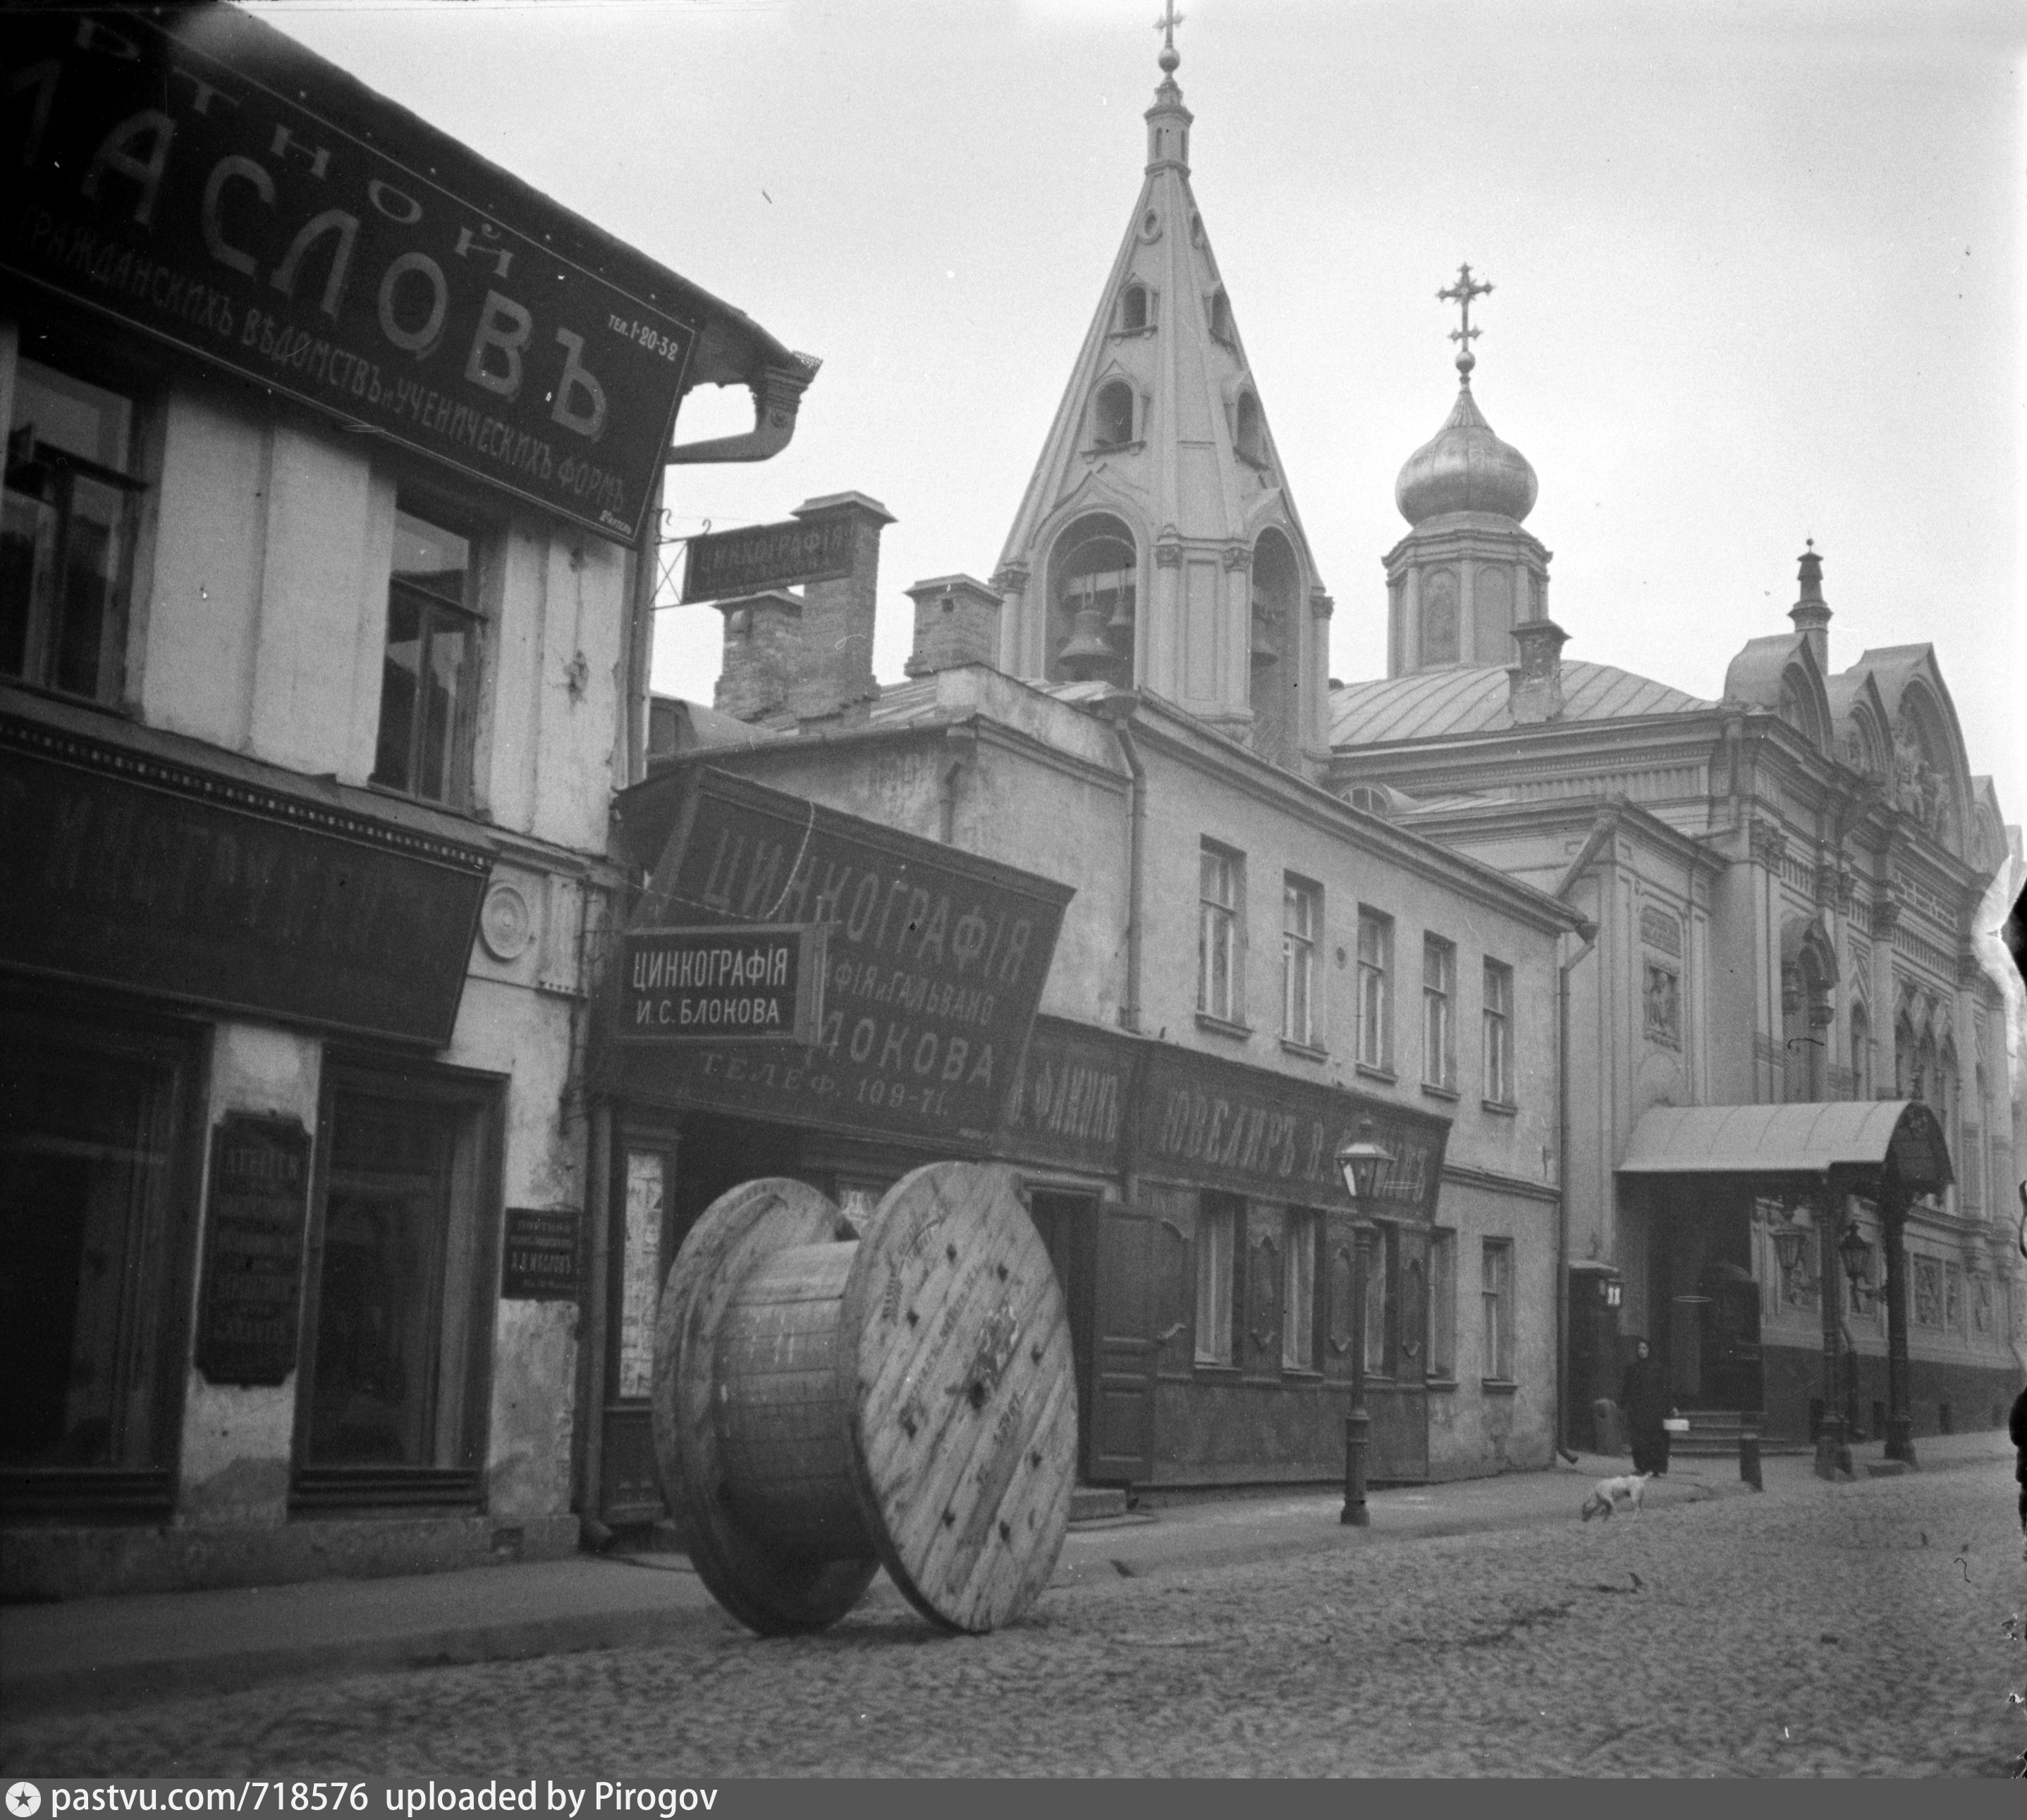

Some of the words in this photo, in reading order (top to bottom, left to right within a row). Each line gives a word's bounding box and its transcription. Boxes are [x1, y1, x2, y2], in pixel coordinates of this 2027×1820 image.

[631, 321, 679, 362] 1-20-32
[394, 377, 553, 480] УЧЕНИЧЕСКИХЪ
[704, 829, 1031, 984] ЦИНКОГРАФІЯ
[633, 945, 788, 990] ЦИНКОГРАФІЯ
[680, 998, 780, 1024] БЛОКОВА
[885, 971, 995, 1026] ГАЛЬВАНО
[700, 1051, 841, 1097] ТЕЛЕФ.
[1163, 1089, 1297, 1178] ЮВЕЛИРЪ
